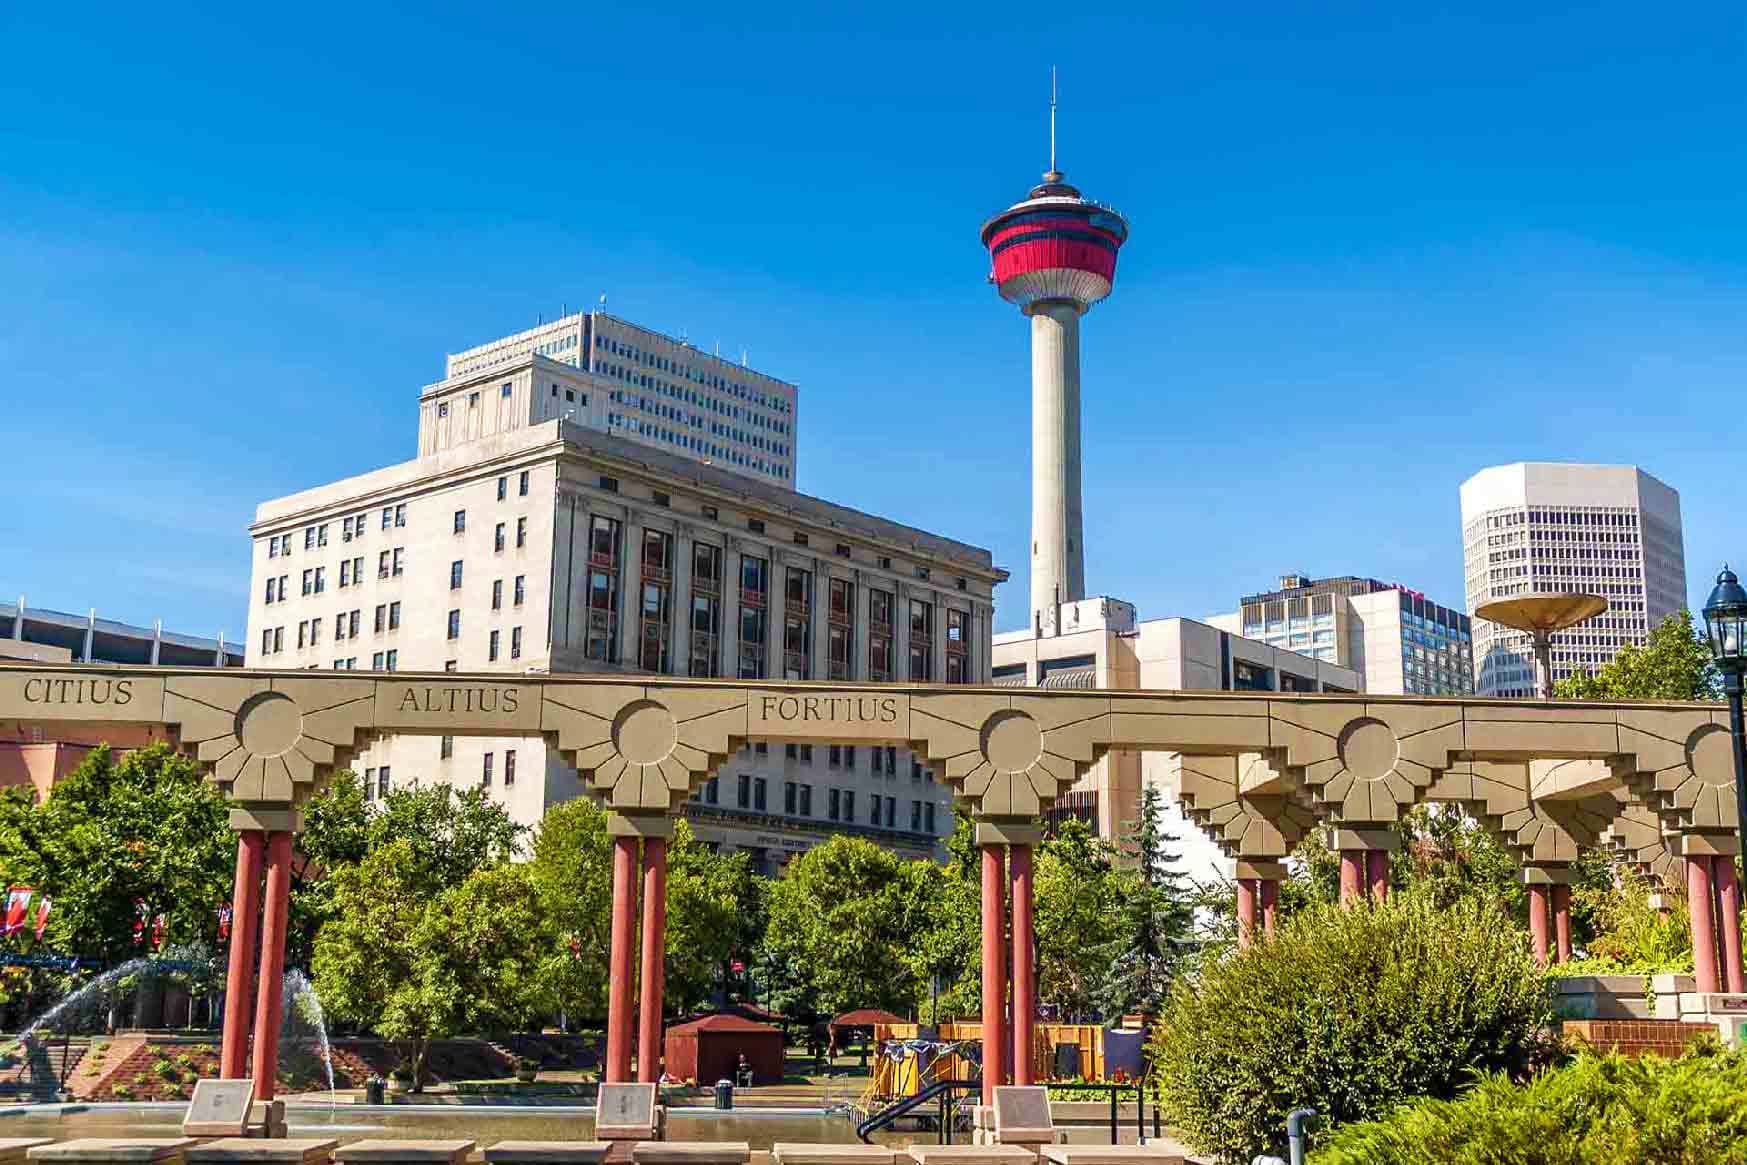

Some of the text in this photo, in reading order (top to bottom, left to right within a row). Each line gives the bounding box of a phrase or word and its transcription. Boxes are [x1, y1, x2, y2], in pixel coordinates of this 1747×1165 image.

[24, 678, 133, 705] CITIUS
[399, 687, 519, 713] ALTIUS
[761, 696, 897, 722] FORTIUS
